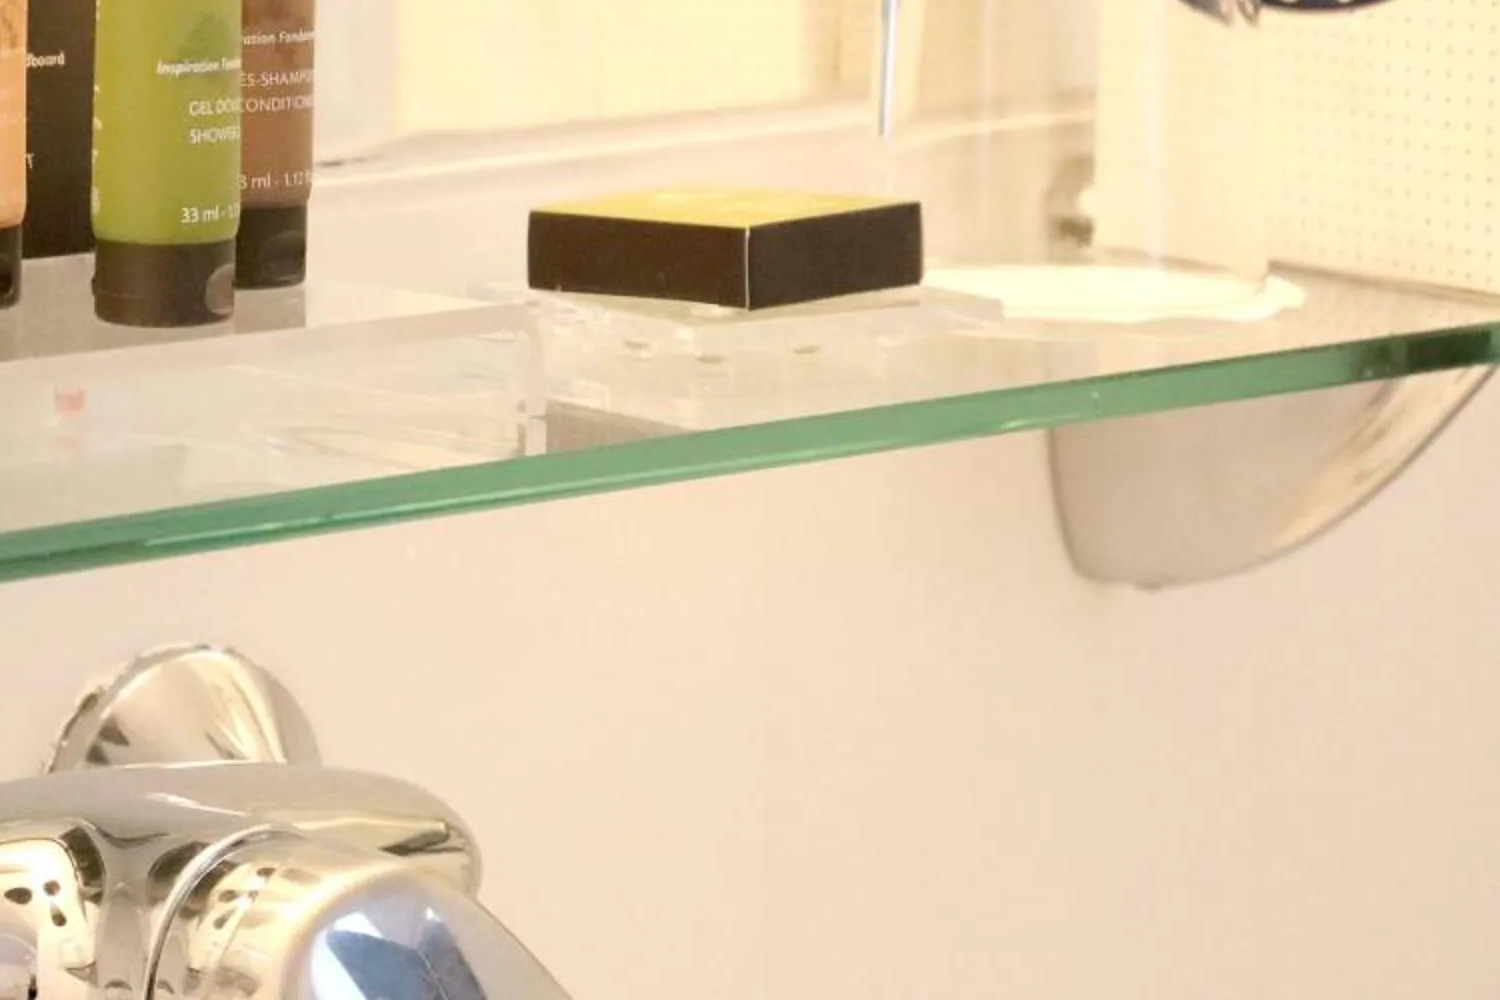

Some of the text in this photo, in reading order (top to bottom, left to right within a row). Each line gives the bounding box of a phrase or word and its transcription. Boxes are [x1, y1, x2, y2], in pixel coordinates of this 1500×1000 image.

[25, 51, 65, 68] dboard
[251, 171, 271, 189] ml
[180, 206, 199, 226] 33
[203, 204, 219, 223] ml
